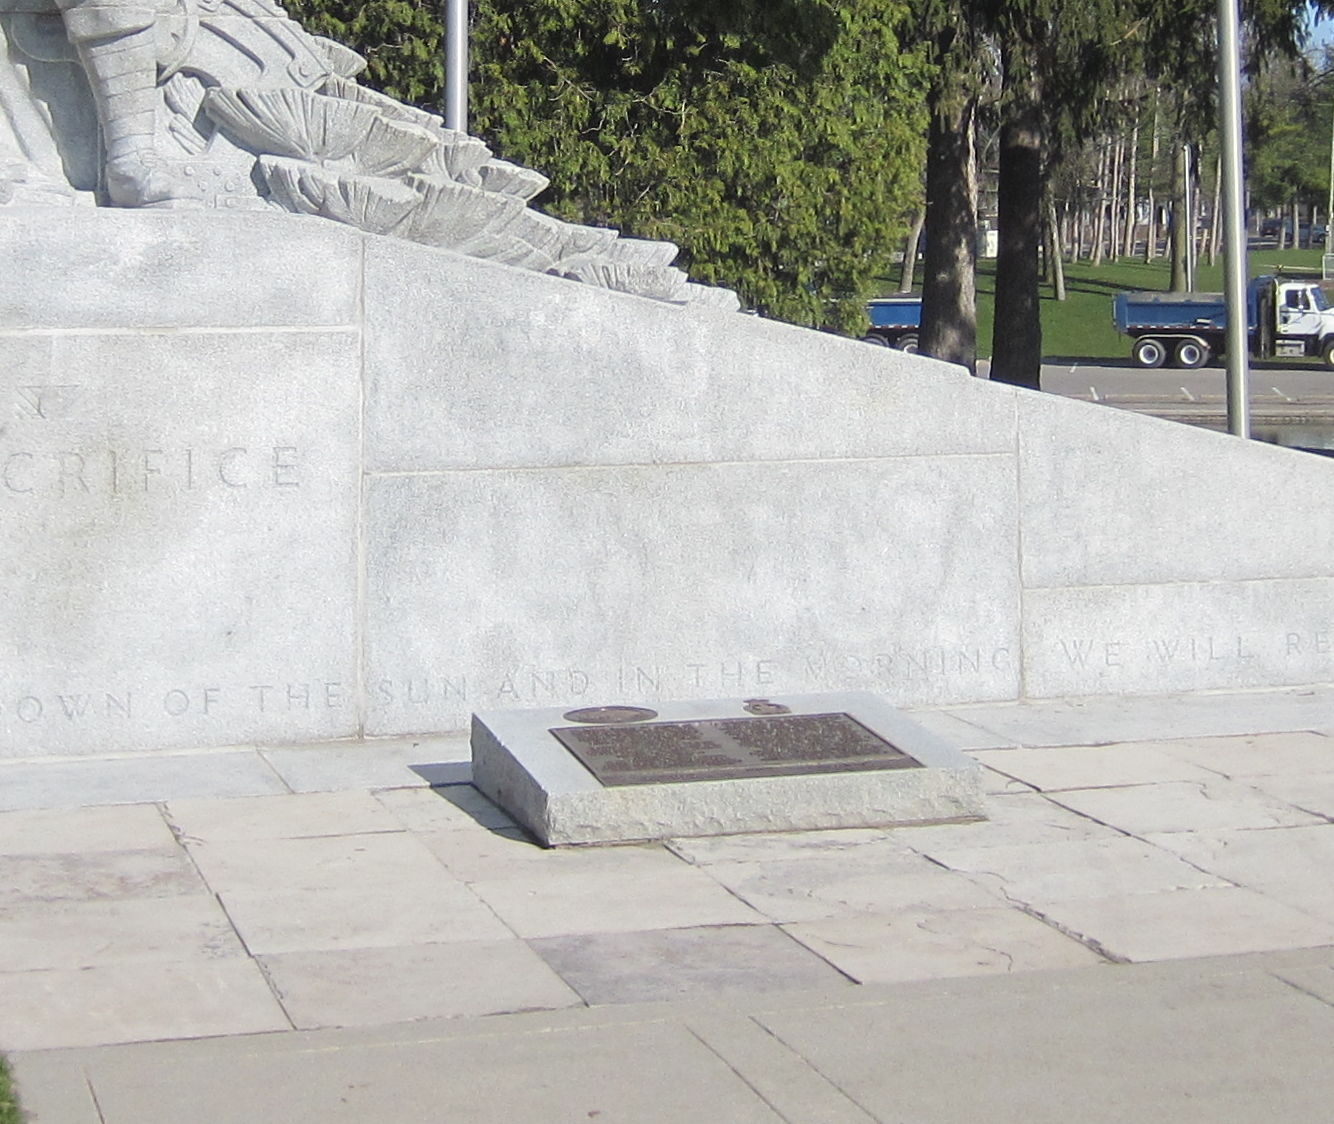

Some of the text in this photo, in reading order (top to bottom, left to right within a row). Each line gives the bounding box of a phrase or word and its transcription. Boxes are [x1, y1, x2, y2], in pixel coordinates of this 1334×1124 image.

[162, 687, 221, 716] OF
[249, 680, 342, 713] THE
[376, 677, 467, 706] SUN
[496, 668, 590, 700] AND
[617, 665, 662, 693] IN
[686, 659, 776, 689] THE
[804, 647, 1012, 683] MORNING
[1059, 637, 1124, 669] WE
[1151, 634, 1256, 663] WILL
